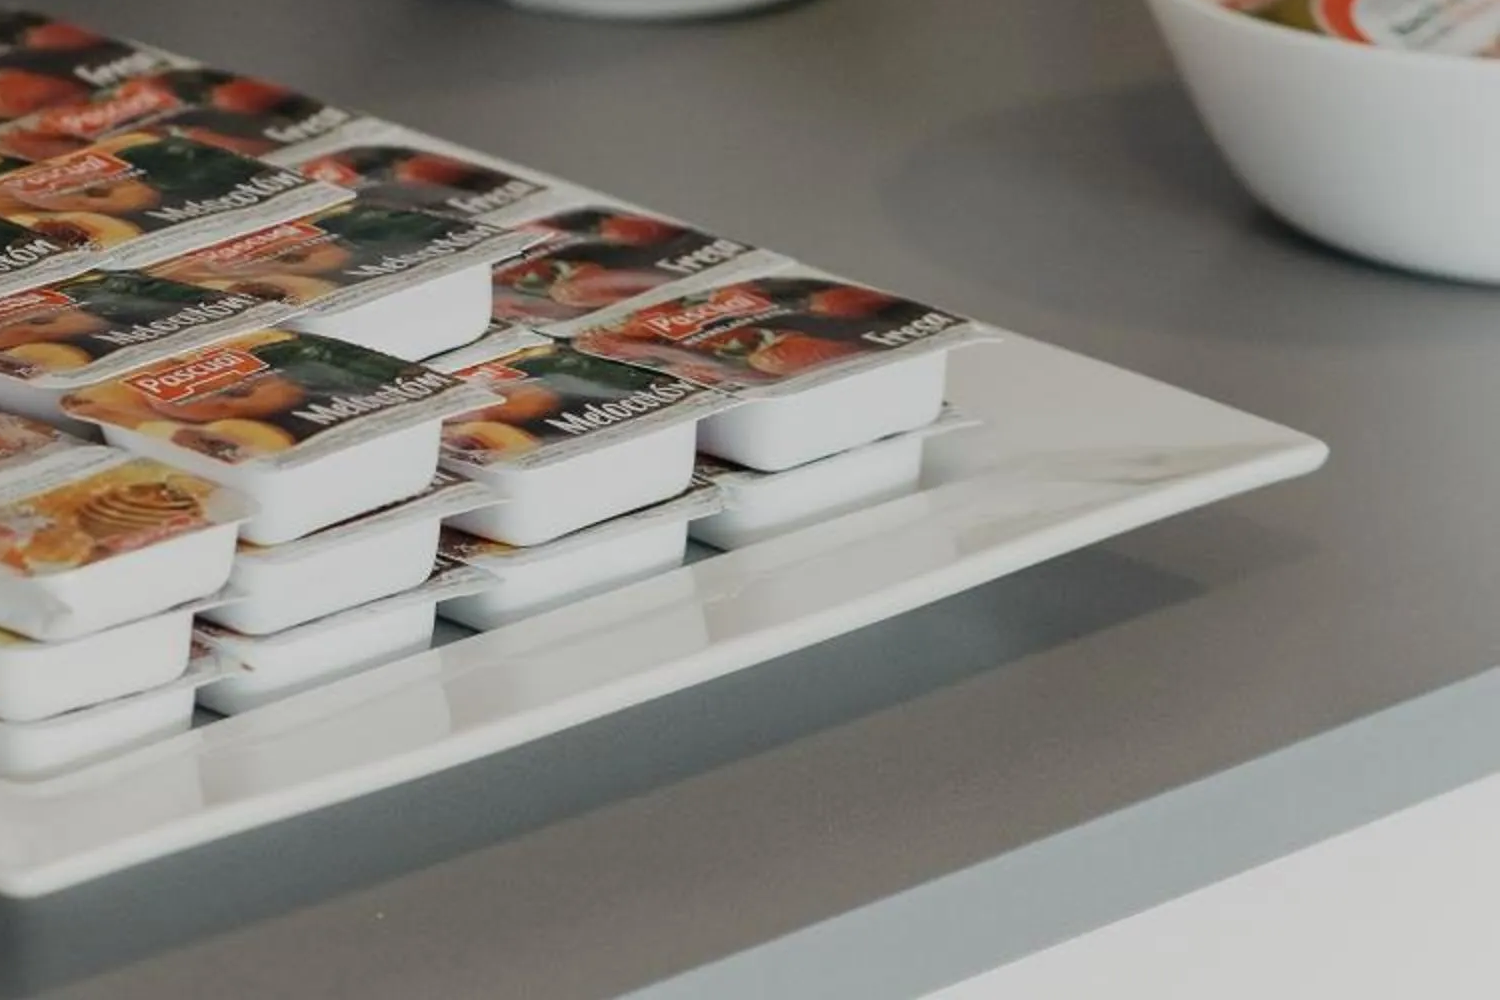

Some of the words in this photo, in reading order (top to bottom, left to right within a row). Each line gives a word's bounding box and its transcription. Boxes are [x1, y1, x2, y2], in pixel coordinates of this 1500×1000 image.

[94, 293, 257, 347] Melocotón
[861, 312, 952, 348] Fresa
[138, 351, 245, 394] Pascual
[292, 371, 452, 426] Melocotón
